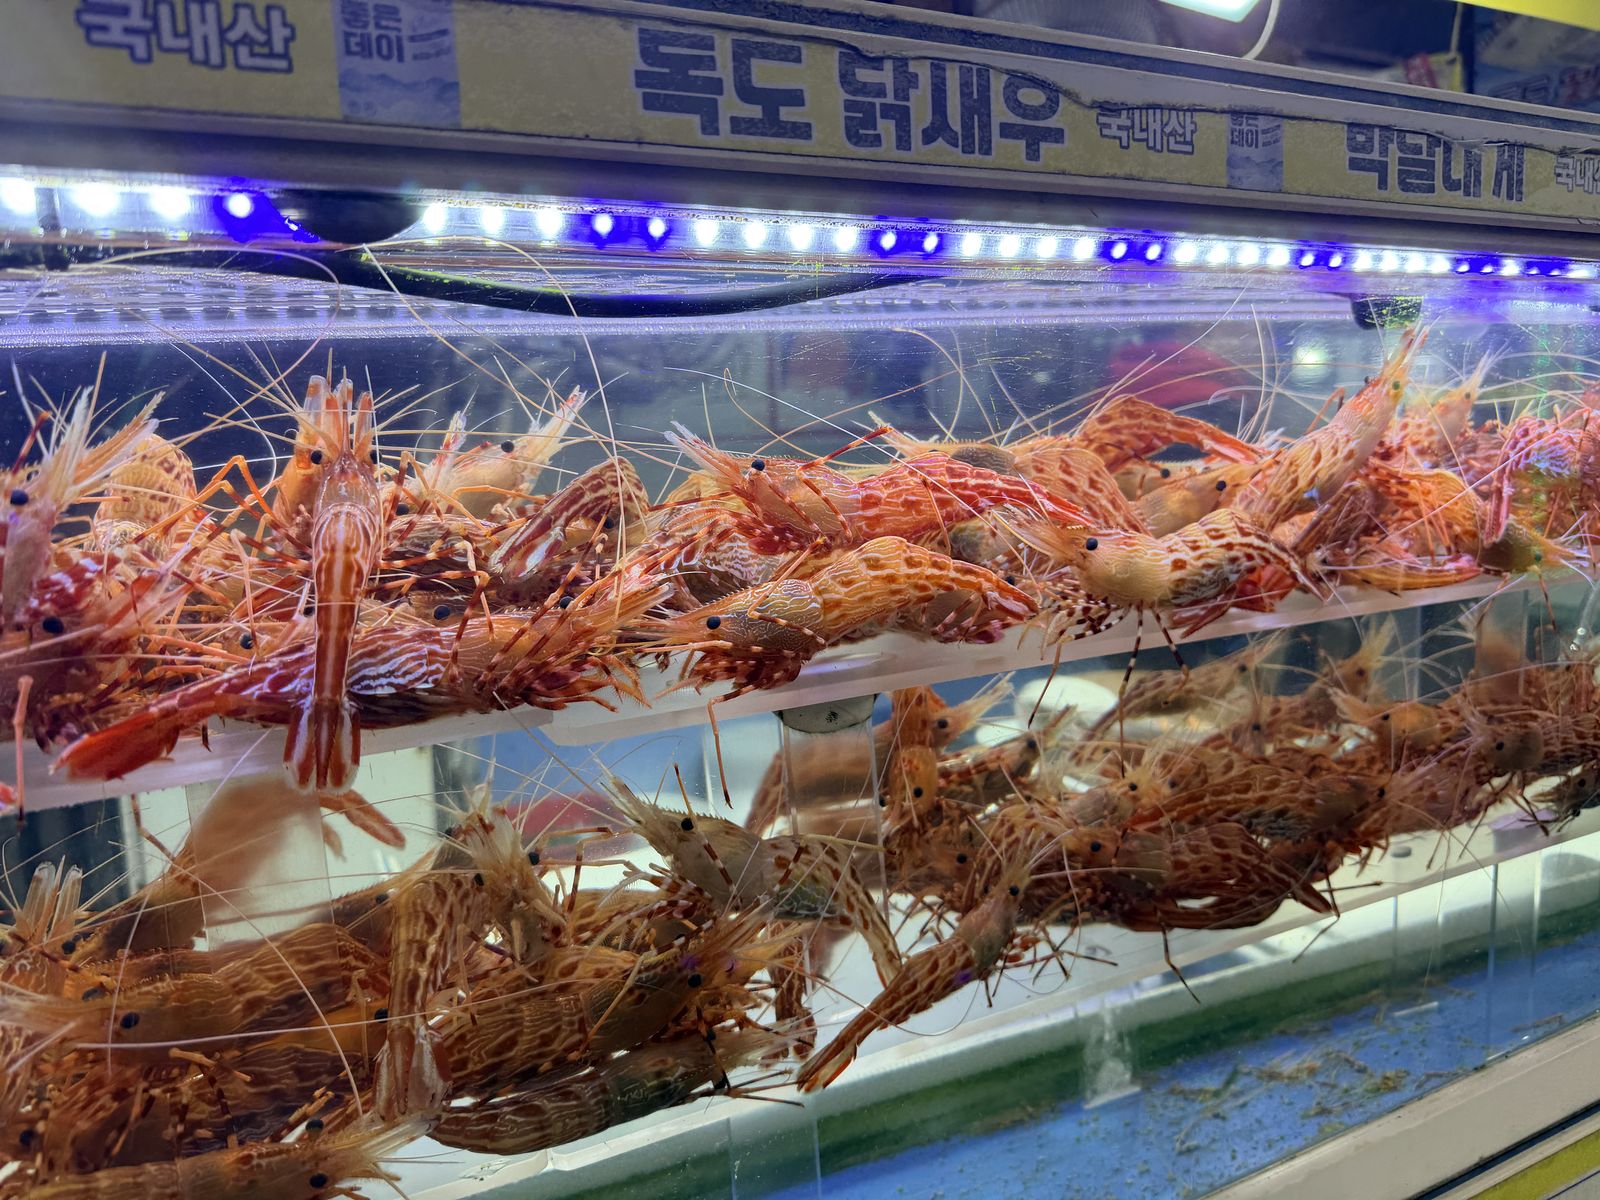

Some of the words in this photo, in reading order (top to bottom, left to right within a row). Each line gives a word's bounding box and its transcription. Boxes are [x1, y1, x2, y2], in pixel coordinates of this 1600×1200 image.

[76, 0, 294, 73] 국내산
[343, 31, 404, 63] 데이
[635, 27, 812, 141] 독도
[838, 50, 1066, 163] 닭새우
[1096, 106, 1197, 155] 국내산
[1231, 127, 1259, 149] 데이
